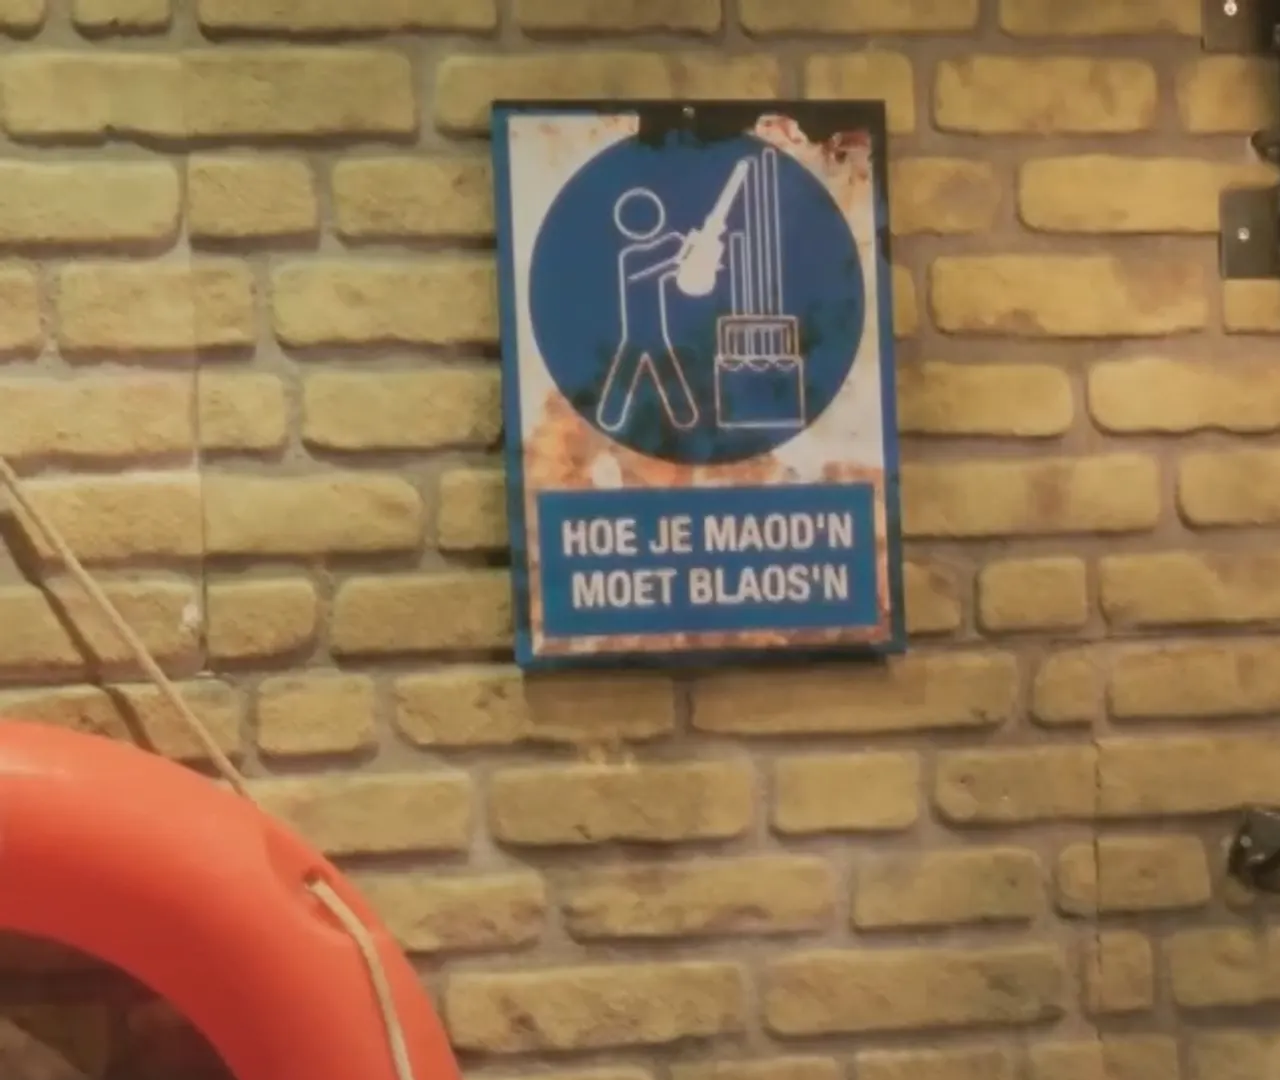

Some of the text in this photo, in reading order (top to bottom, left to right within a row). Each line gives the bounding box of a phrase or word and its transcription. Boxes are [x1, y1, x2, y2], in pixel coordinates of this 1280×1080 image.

[562, 511, 853, 557] HOE JE MAOD'N
[571, 563, 849, 609] MOET BLAOS'N
